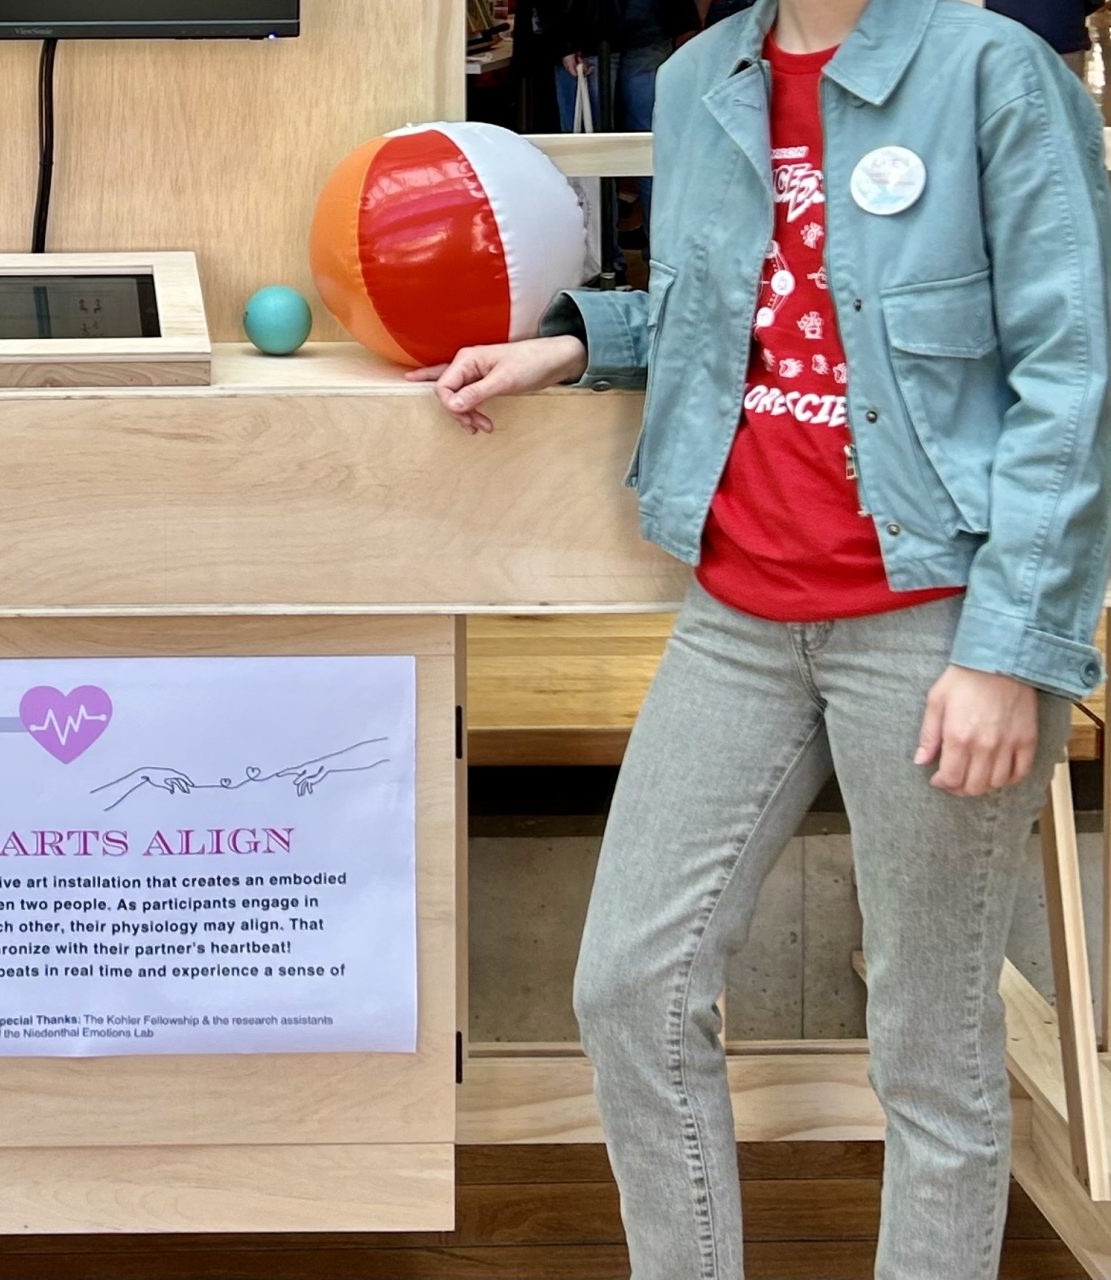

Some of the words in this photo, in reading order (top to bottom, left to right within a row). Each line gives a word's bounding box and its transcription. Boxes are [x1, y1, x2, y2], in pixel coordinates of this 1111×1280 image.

[143, 828, 294, 856] ALIGN
[27, 877, 48, 888] art
[53, 875, 141, 888] installation
[146, 876, 177, 888] that
[182, 875, 240, 887] creates
[245, 876, 264, 886] an
[269, 872, 346, 886] embodied
[20, 899, 48, 910] two
[54, 898, 111, 913] people.
[117, 898, 136, 911] As
[143, 897, 236, 914] participants
[242, 898, 299, 911] engage
[305, 896, 318, 908] in
[19, 920, 64, 934] other,
[70, 920, 106, 932] their
[112, 920, 198, 937] physiology
[204, 921, 235, 934] may
[241, 918, 284, 934] align.
[289, 918, 324, 930] That
[55, 942, 88, 954] with
[93, 941, 129, 955] their
[135, 941, 205, 957] partner's
[211, 941, 291, 954] heartbeat!
[45, 964, 58, 976] in
[65, 964, 93, 976] real
[99, 964, 133, 977] time
[138, 965, 166, 977] and
[172, 964, 259, 980] experience
[264, 967, 272, 976] a
[279, 966, 325, 976] sense
[330, 963, 345, 976] of
[36, 1015, 81, 1026] Thanks:
[83, 1015, 104, 1026] The
[107, 1015, 141, 1026] Kohler
[144, 1015, 199, 1028] Fellowship
[202, 1015, 210, 1025] &
[213, 1015, 229, 1025] the
[232, 1015, 278, 1025] research
[281, 1015, 333, 1025] assistants
[4, 1028, 20, 1039] the
[23, 1027, 79, 1038] Niedenthal
[82, 1027, 131, 1038] Emotions
[134, 1027, 154, 1038] Lab
